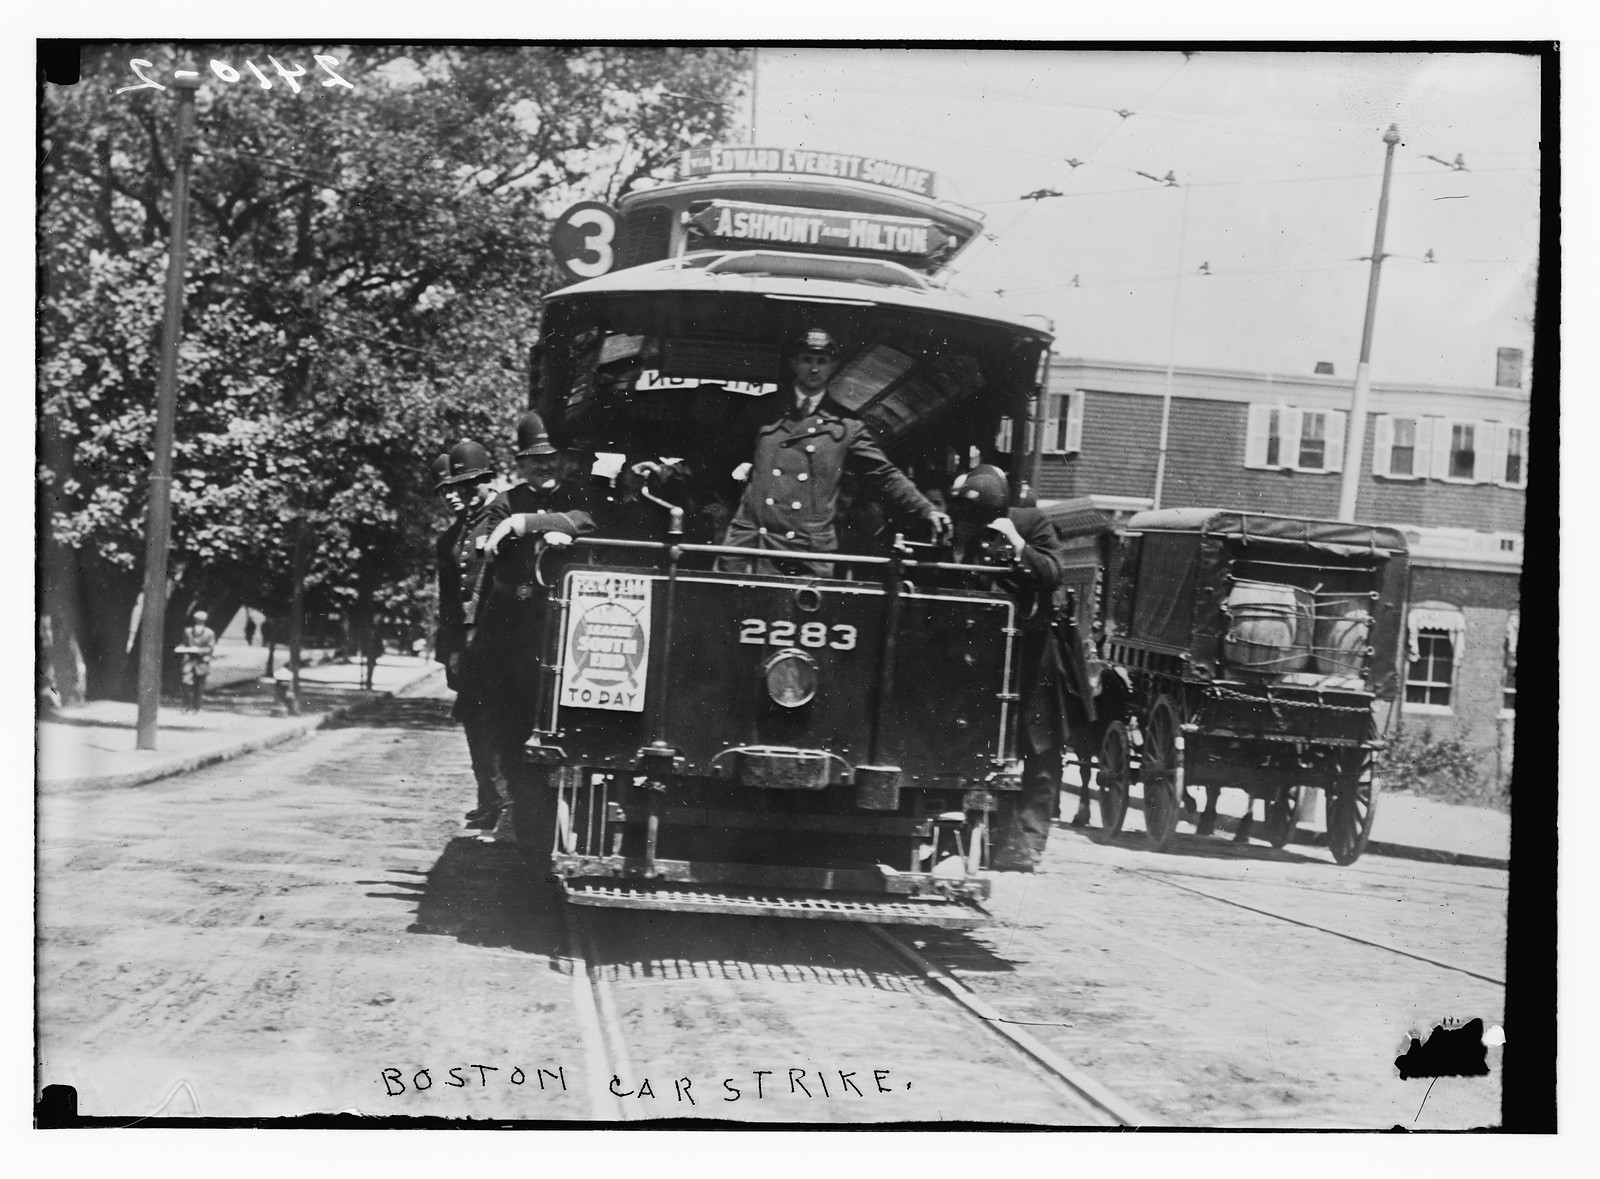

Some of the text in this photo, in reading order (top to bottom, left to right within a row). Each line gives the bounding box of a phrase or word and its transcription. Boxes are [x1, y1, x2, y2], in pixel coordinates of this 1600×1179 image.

[710, 148, 780, 173] EDWARD
[782, 149, 861, 177] EVERETT
[862, 157, 932, 194] SQUARE
[566, 209, 616, 278] 3
[713, 207, 823, 244] ASHMONT
[849, 219, 928, 253] MILTON
[739, 618, 858, 651] 2283
